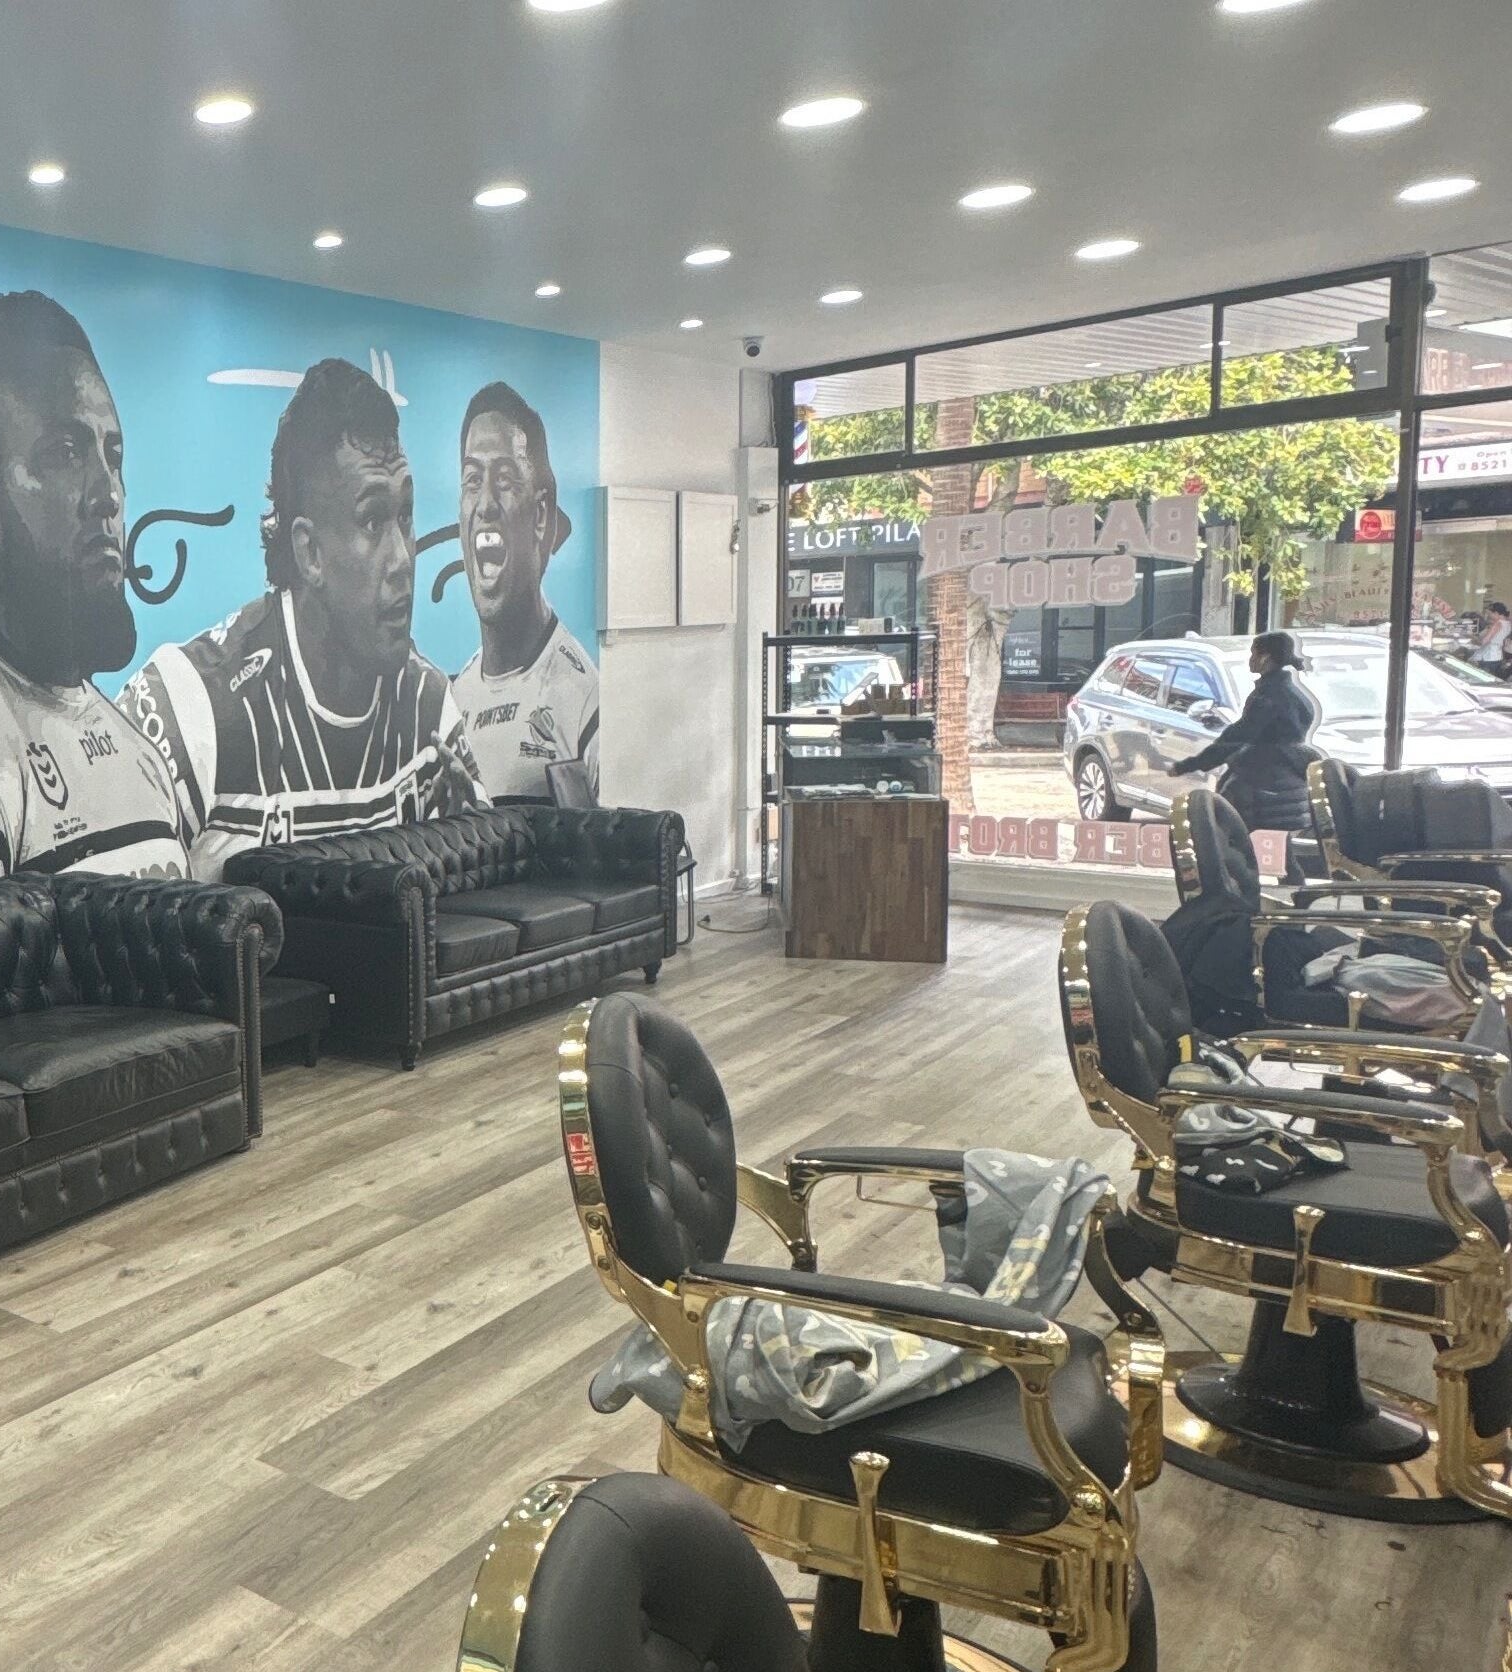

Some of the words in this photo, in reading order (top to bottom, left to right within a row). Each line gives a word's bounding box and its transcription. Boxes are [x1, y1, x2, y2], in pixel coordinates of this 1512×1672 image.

[803, 526, 862, 551] LOFT
[1014, 647, 1033, 657] for
[1008, 657, 1037, 668] lease
[78, 730, 119, 766] pilot
